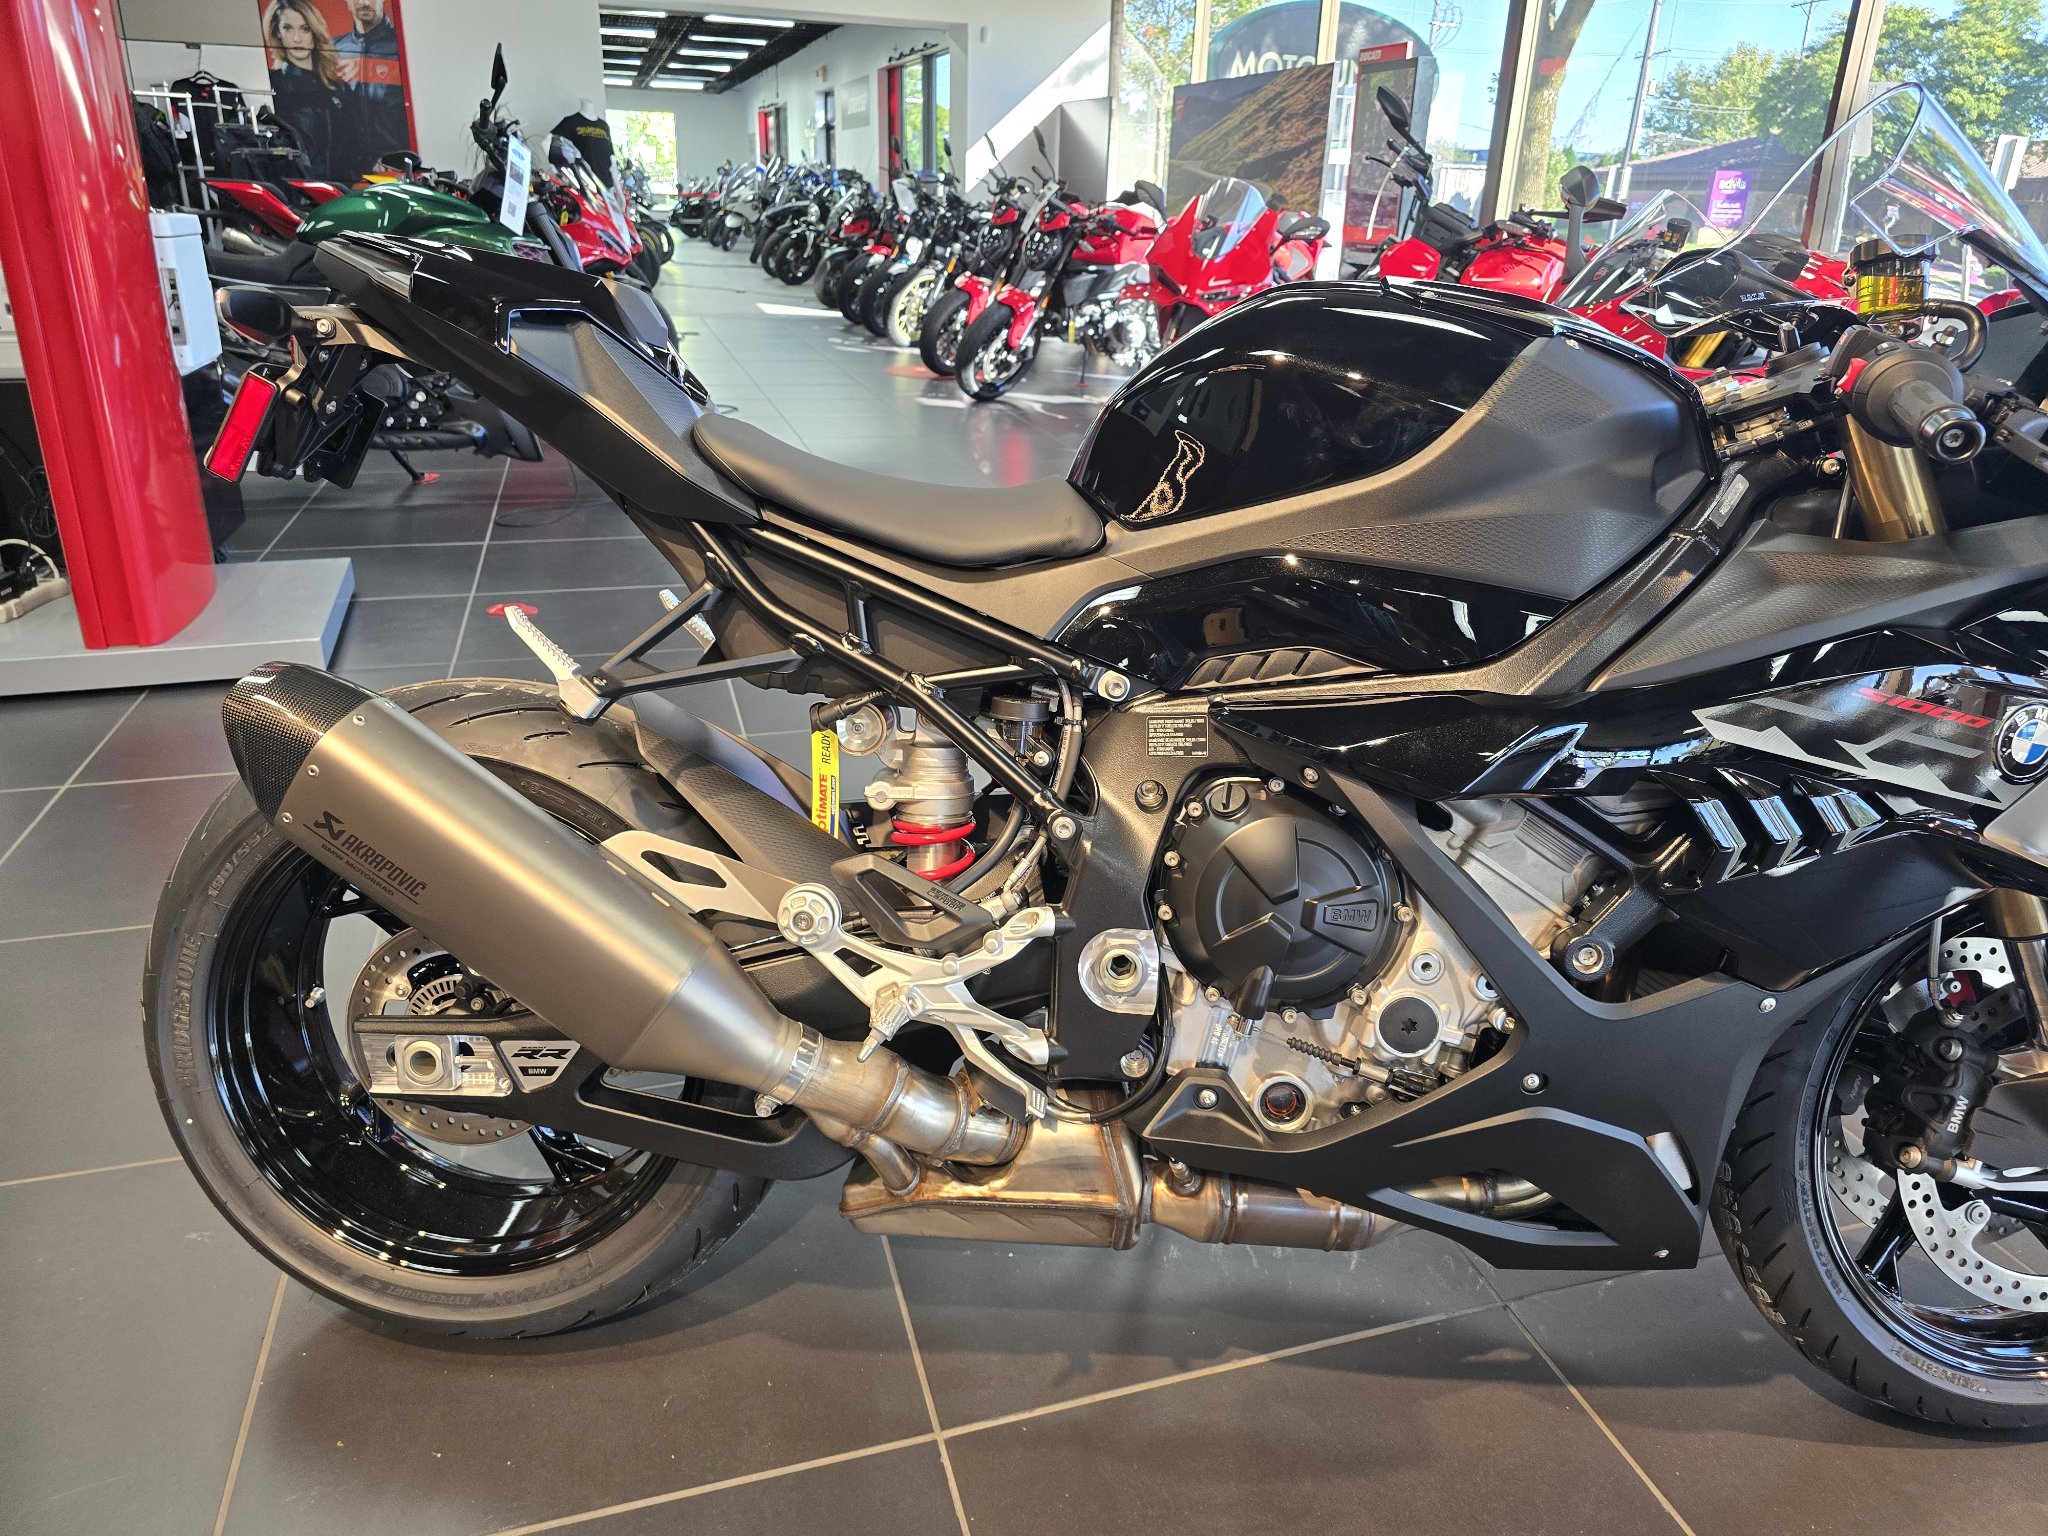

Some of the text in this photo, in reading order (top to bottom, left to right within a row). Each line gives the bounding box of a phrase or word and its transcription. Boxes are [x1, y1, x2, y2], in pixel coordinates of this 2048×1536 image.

[820, 732, 831, 765] READY
[816, 773, 829, 833] ptiMATE
[321, 843, 344, 861] BMW
[345, 861, 395, 896] MOTORRAD
[1331, 908, 1372, 922] BMW
[172, 933, 204, 1088] BRIDGESTONE
[511, 1049, 572, 1060] RR
[1946, 1094, 1970, 1134] BMW
